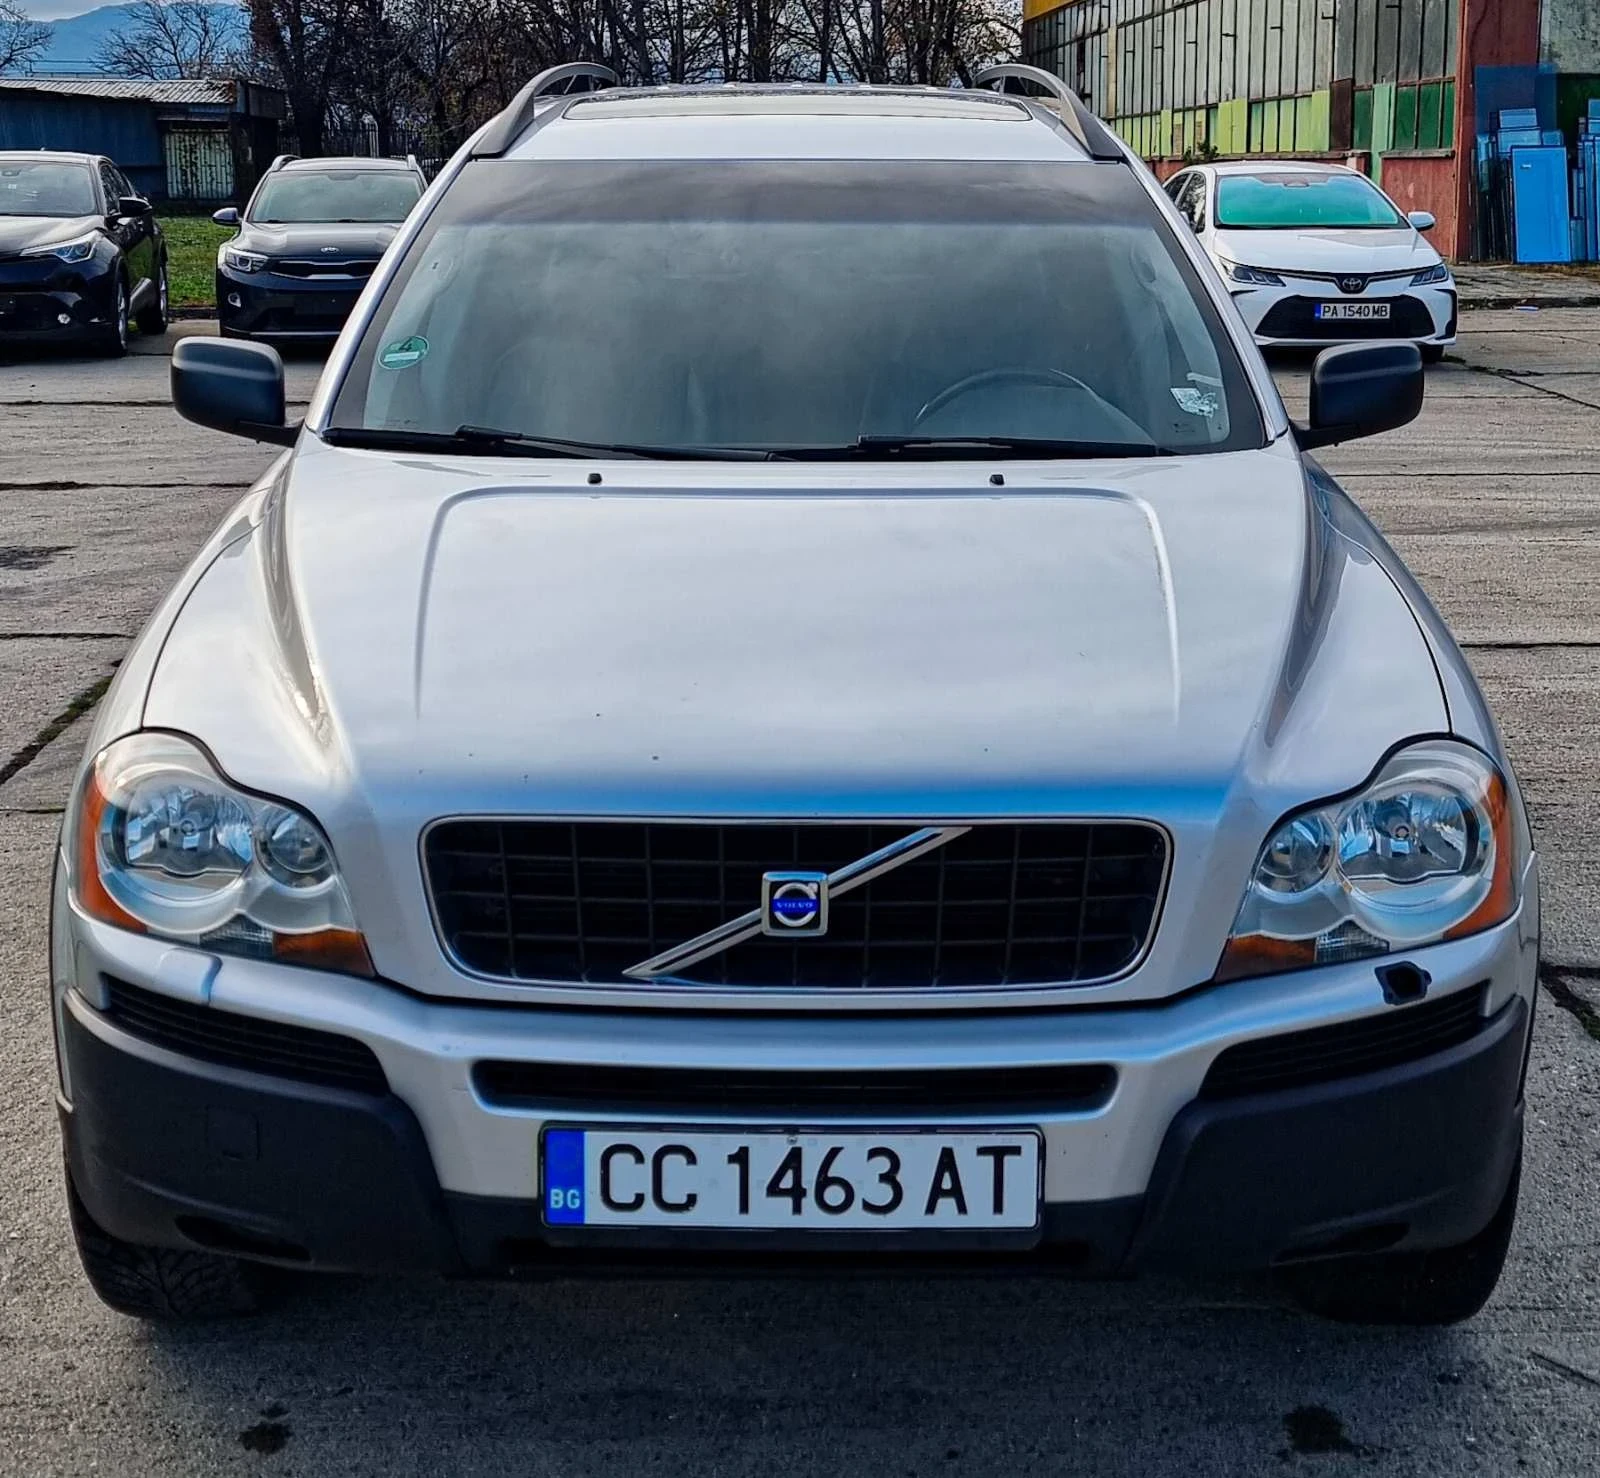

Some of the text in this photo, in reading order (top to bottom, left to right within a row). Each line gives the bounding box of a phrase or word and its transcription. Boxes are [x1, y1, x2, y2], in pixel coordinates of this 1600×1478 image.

[1322, 305, 1338, 317] PA
[1342, 305, 1370, 317] 1540
[1372, 305, 1388, 317] MB
[549, 1143, 1022, 1215] BG CC 1463 AT
